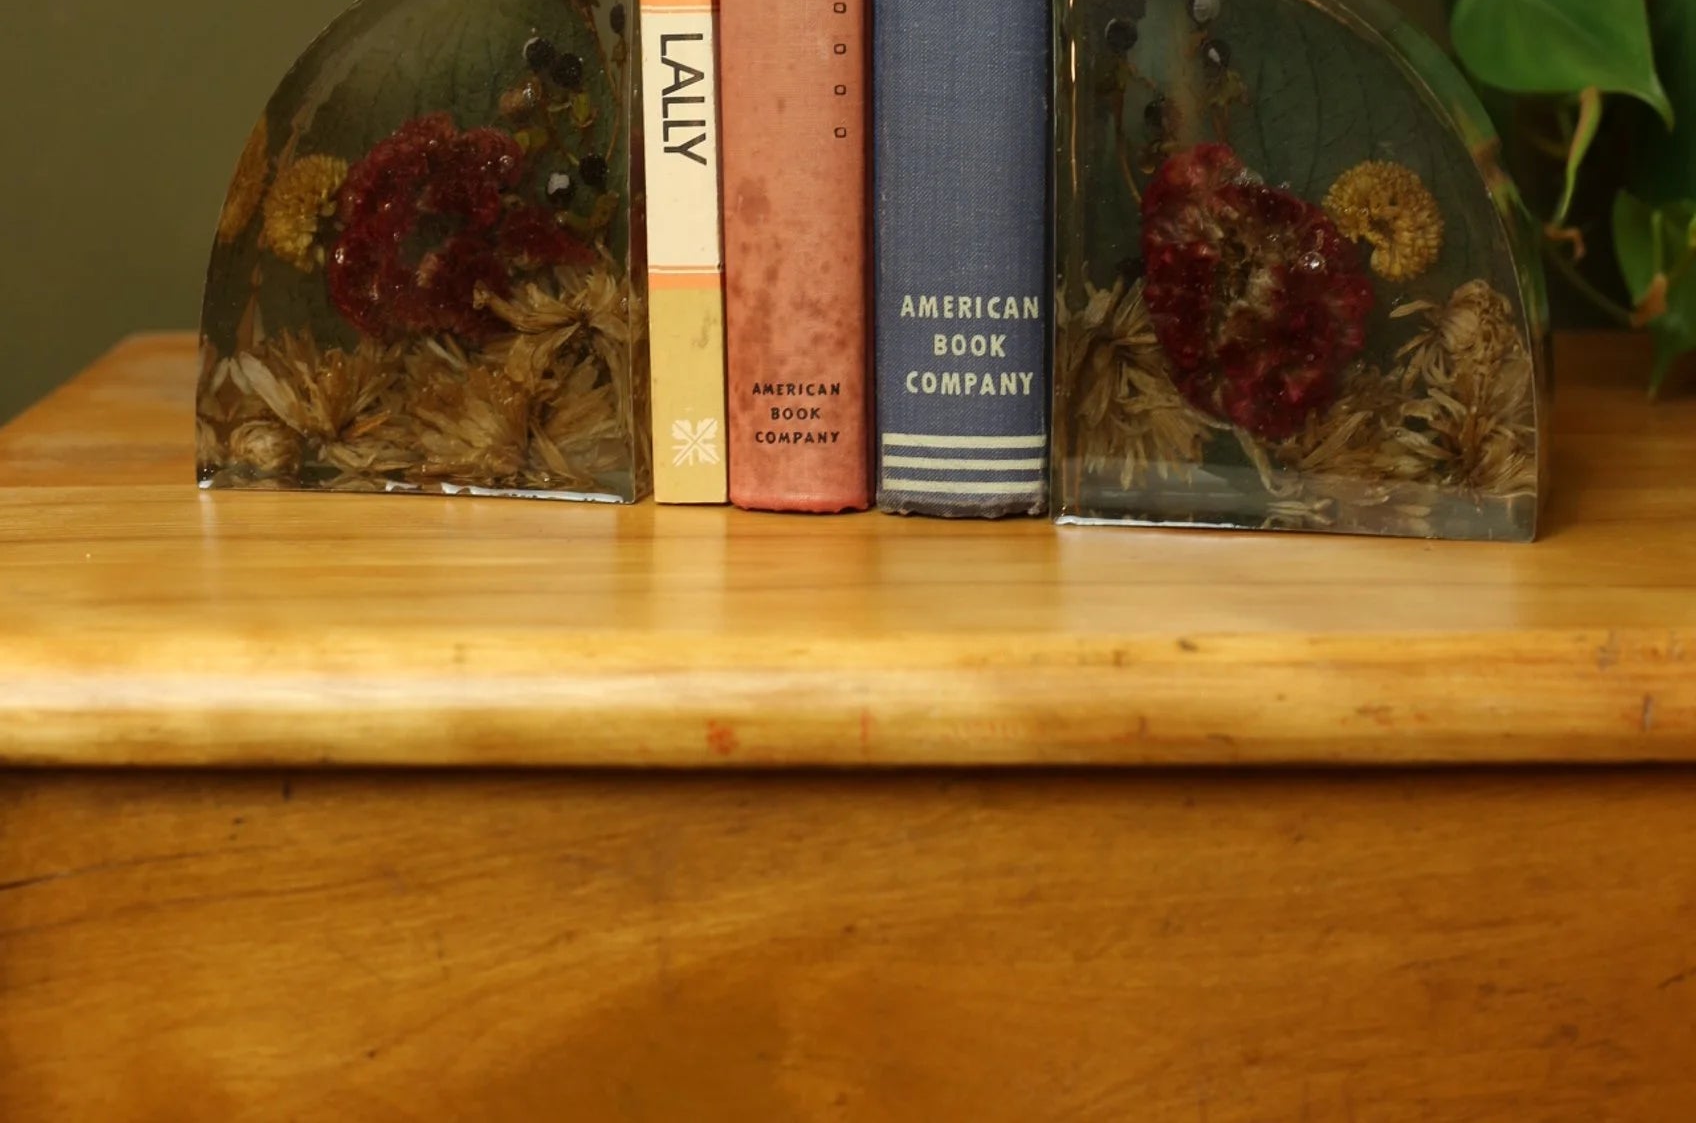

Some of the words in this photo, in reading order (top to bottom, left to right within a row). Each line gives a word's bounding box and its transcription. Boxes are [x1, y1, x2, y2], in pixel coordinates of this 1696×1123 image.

[660, 33, 708, 166] LALLY
[900, 294, 1040, 320] AMERICAN
[933, 333, 1008, 358] BOOK
[752, 382, 841, 397] AMERICAN
[906, 370, 1035, 396] COMPANY
[770, 406, 821, 420] BOOK
[755, 431, 841, 445] COMPANY
